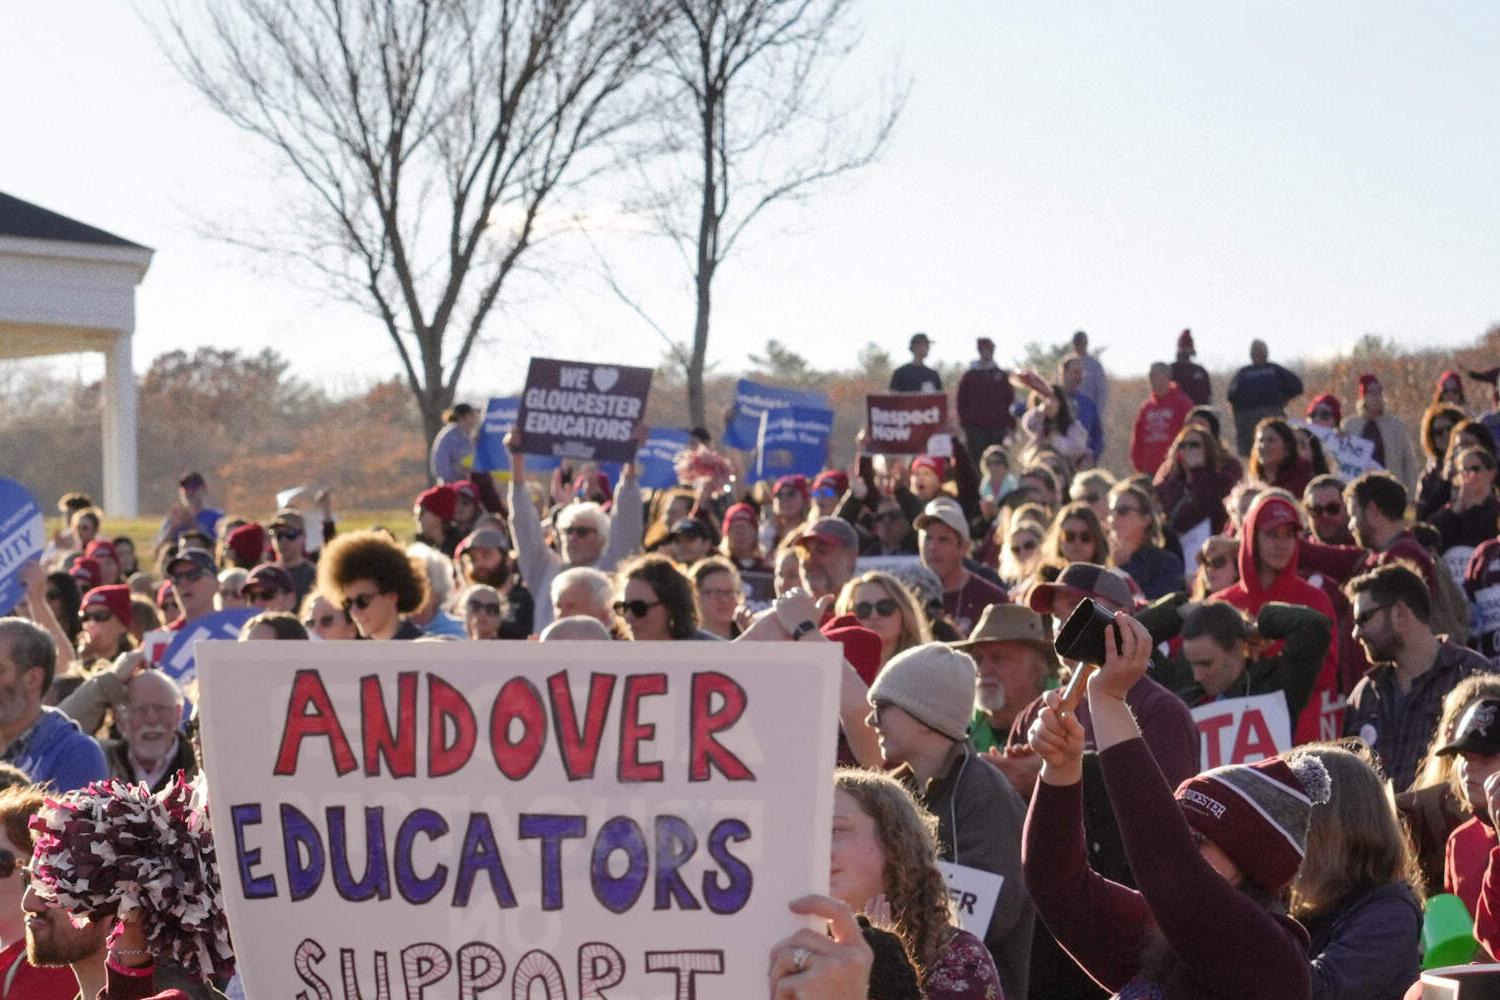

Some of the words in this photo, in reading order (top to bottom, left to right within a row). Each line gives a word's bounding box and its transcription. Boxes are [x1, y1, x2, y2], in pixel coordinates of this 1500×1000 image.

[560, 366, 591, 389] WE
[525, 386, 642, 420] GLOUCESTER
[871, 405, 941, 425] Respect
[524, 411, 633, 443] EDUCATORS
[871, 424, 913, 441] Now
[273, 668, 757, 784] ANDOVER
[230, 802, 754, 915] EDUCATORS
